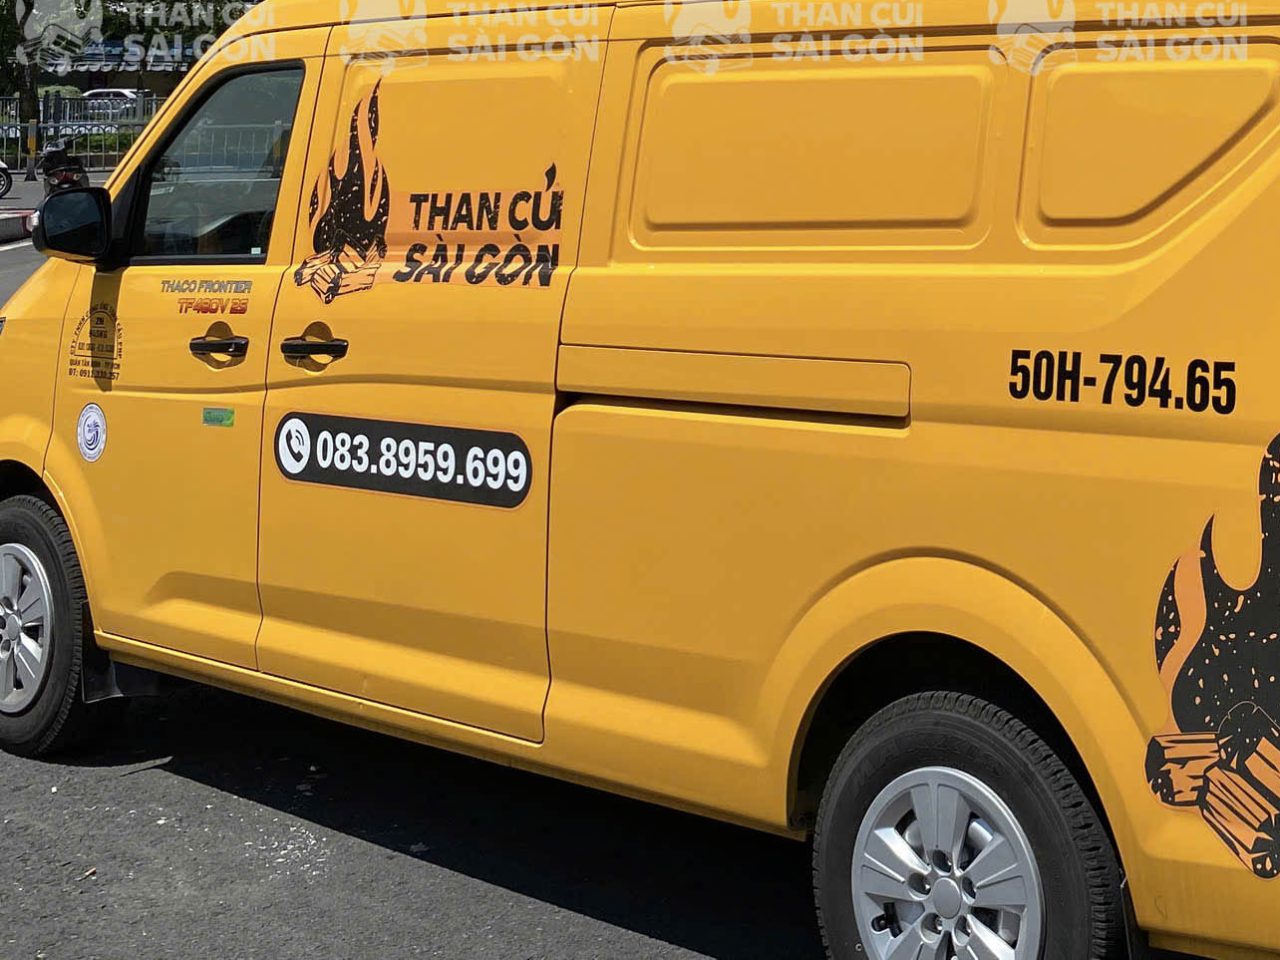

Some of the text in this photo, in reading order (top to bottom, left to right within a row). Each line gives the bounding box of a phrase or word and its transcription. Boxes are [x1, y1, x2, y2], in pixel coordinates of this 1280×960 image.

[409, 191, 502, 231] THAN
[160, 279, 252, 294] THACO FRONTIER
[393, 233, 560, 288] SÀI GÒN
[1009, 350, 1238, 415] 50H-794.65
[316, 430, 527, 493] 083.8959.699
